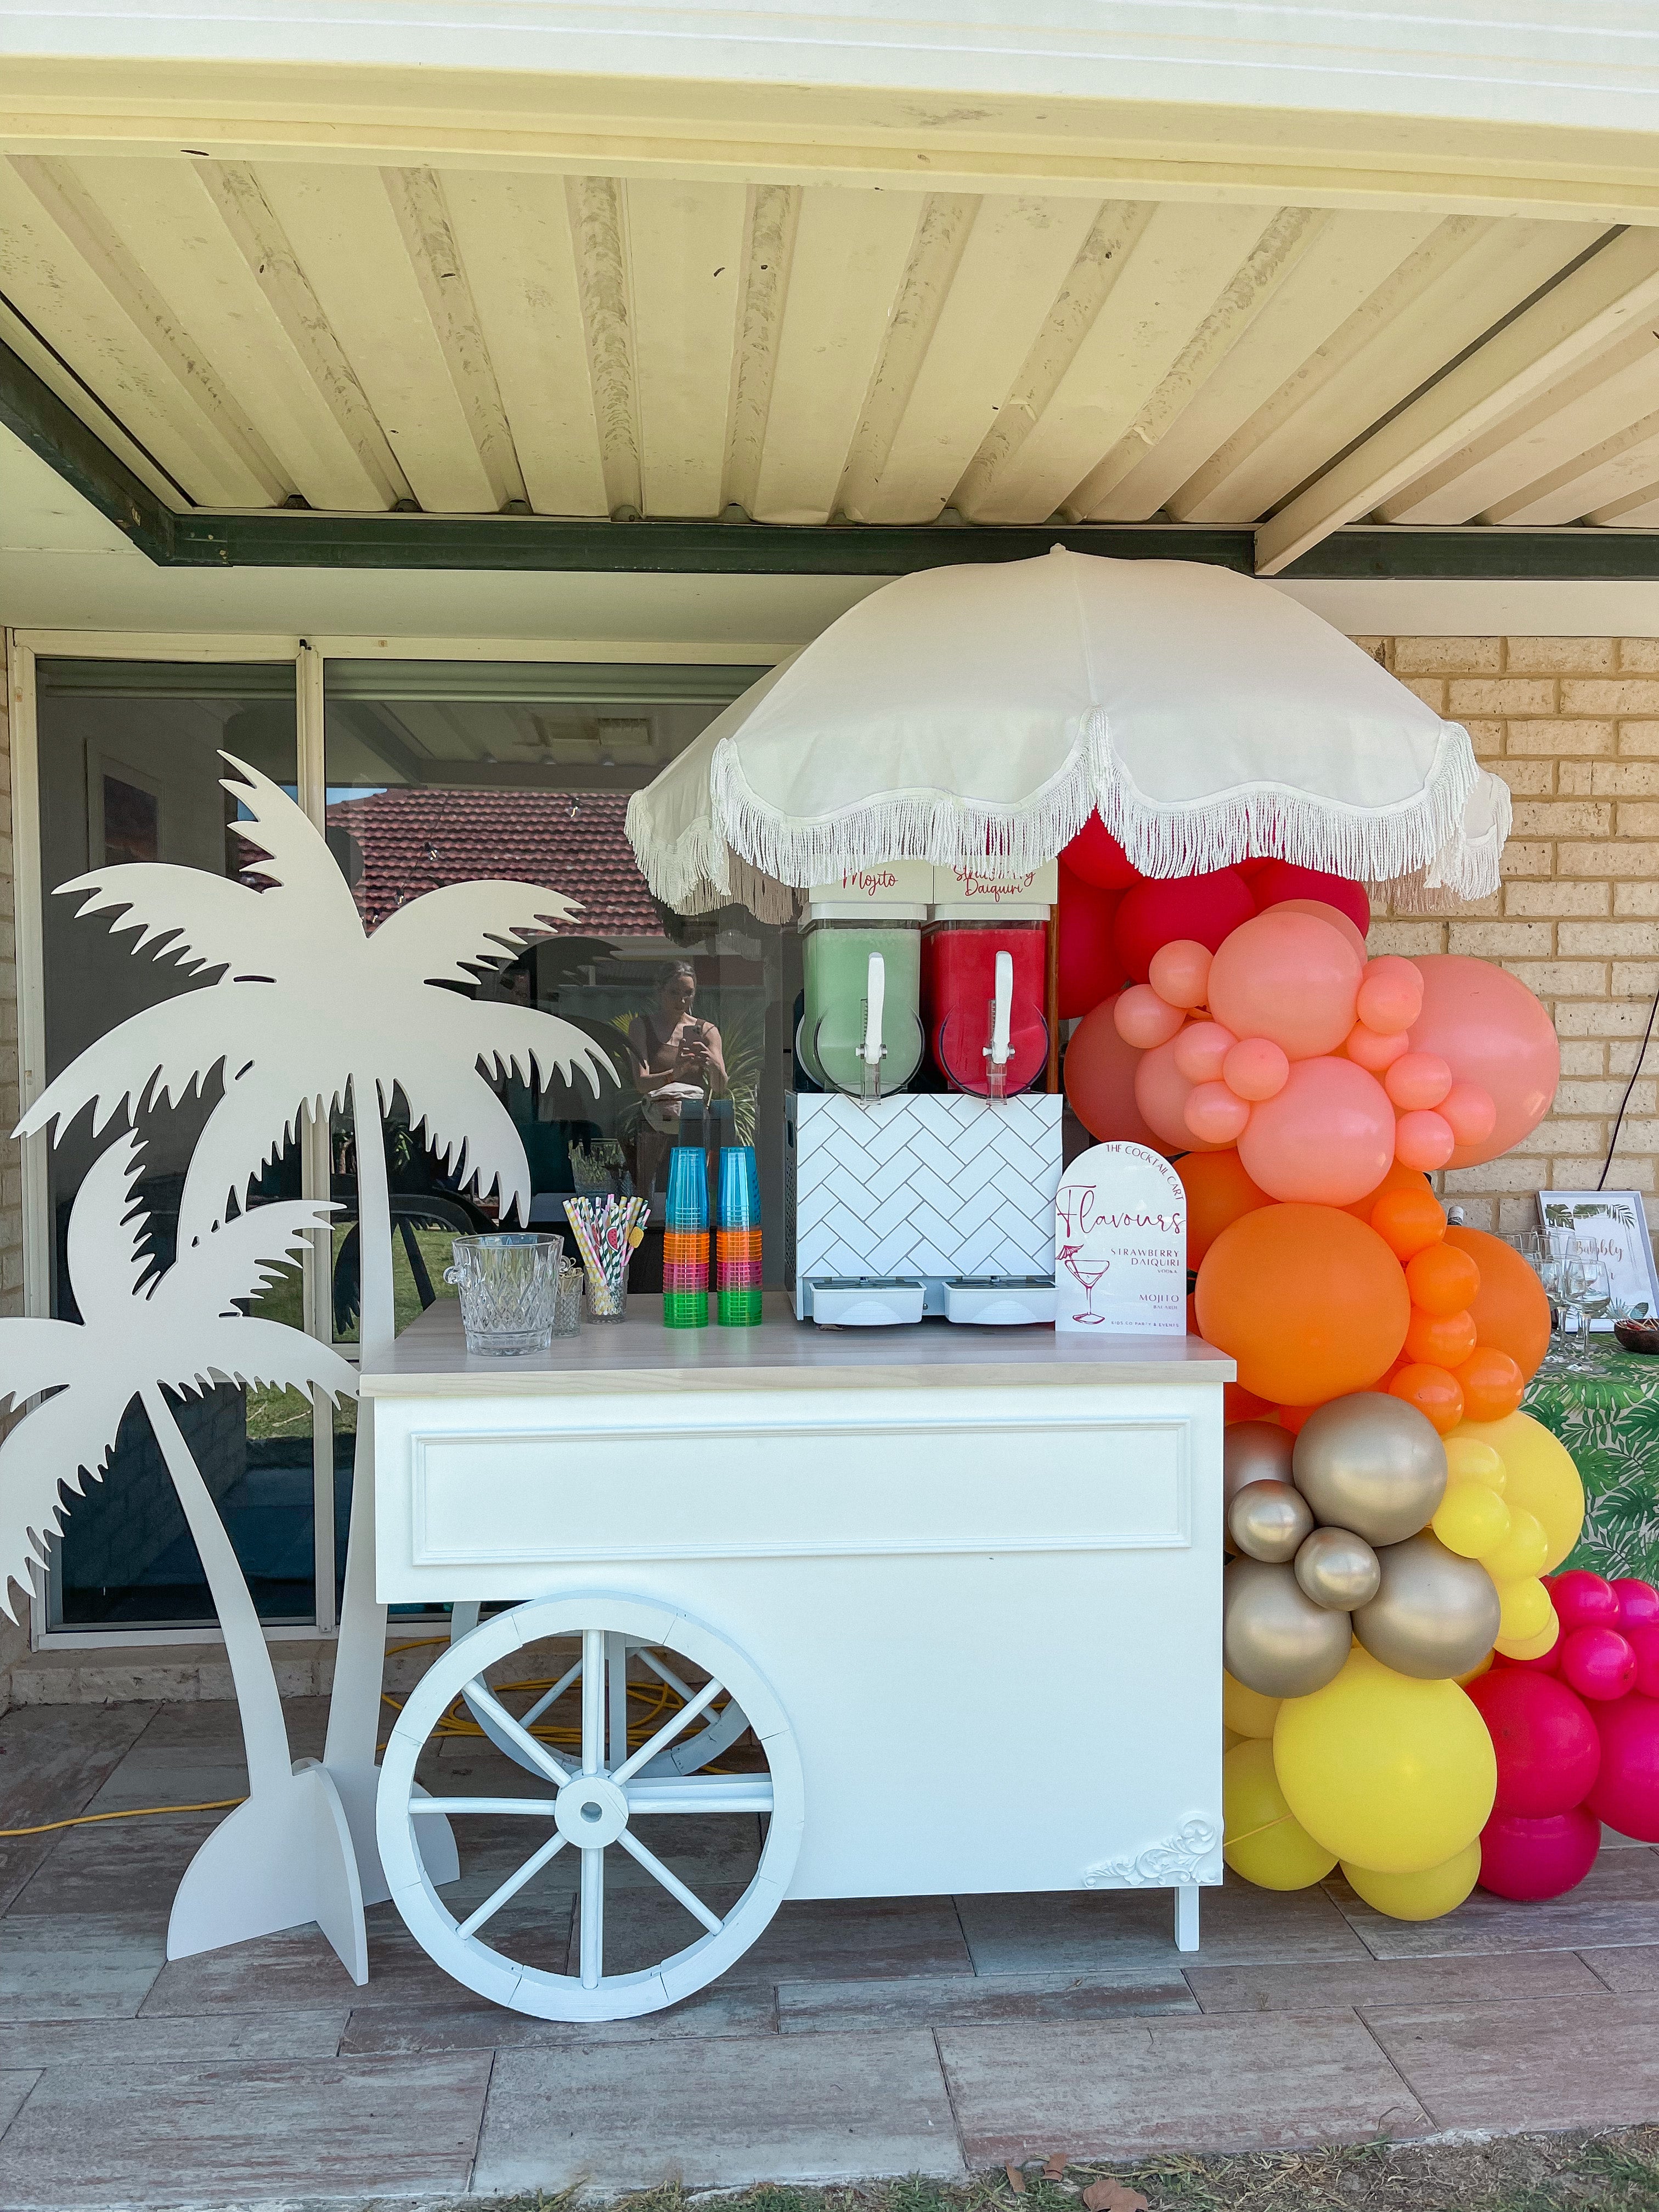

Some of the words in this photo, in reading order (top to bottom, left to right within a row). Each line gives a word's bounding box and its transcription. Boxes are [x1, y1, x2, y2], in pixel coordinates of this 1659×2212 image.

[843, 867, 899, 896] Mojito
[963, 877, 1024, 902] Daiquiri
[1105, 1144, 1122, 1153] THE
[1125, 1146, 1169, 1176] COCKTAIL
[1167, 1176, 1184, 1200] CART
[1055, 1184, 1186, 1238] Flavours
[1110, 1248, 1179, 1257] STRAWBERRY
[1131, 1257, 1180, 1267] DAIQUIRI
[1139, 1294, 1180, 1303] MOJITO
